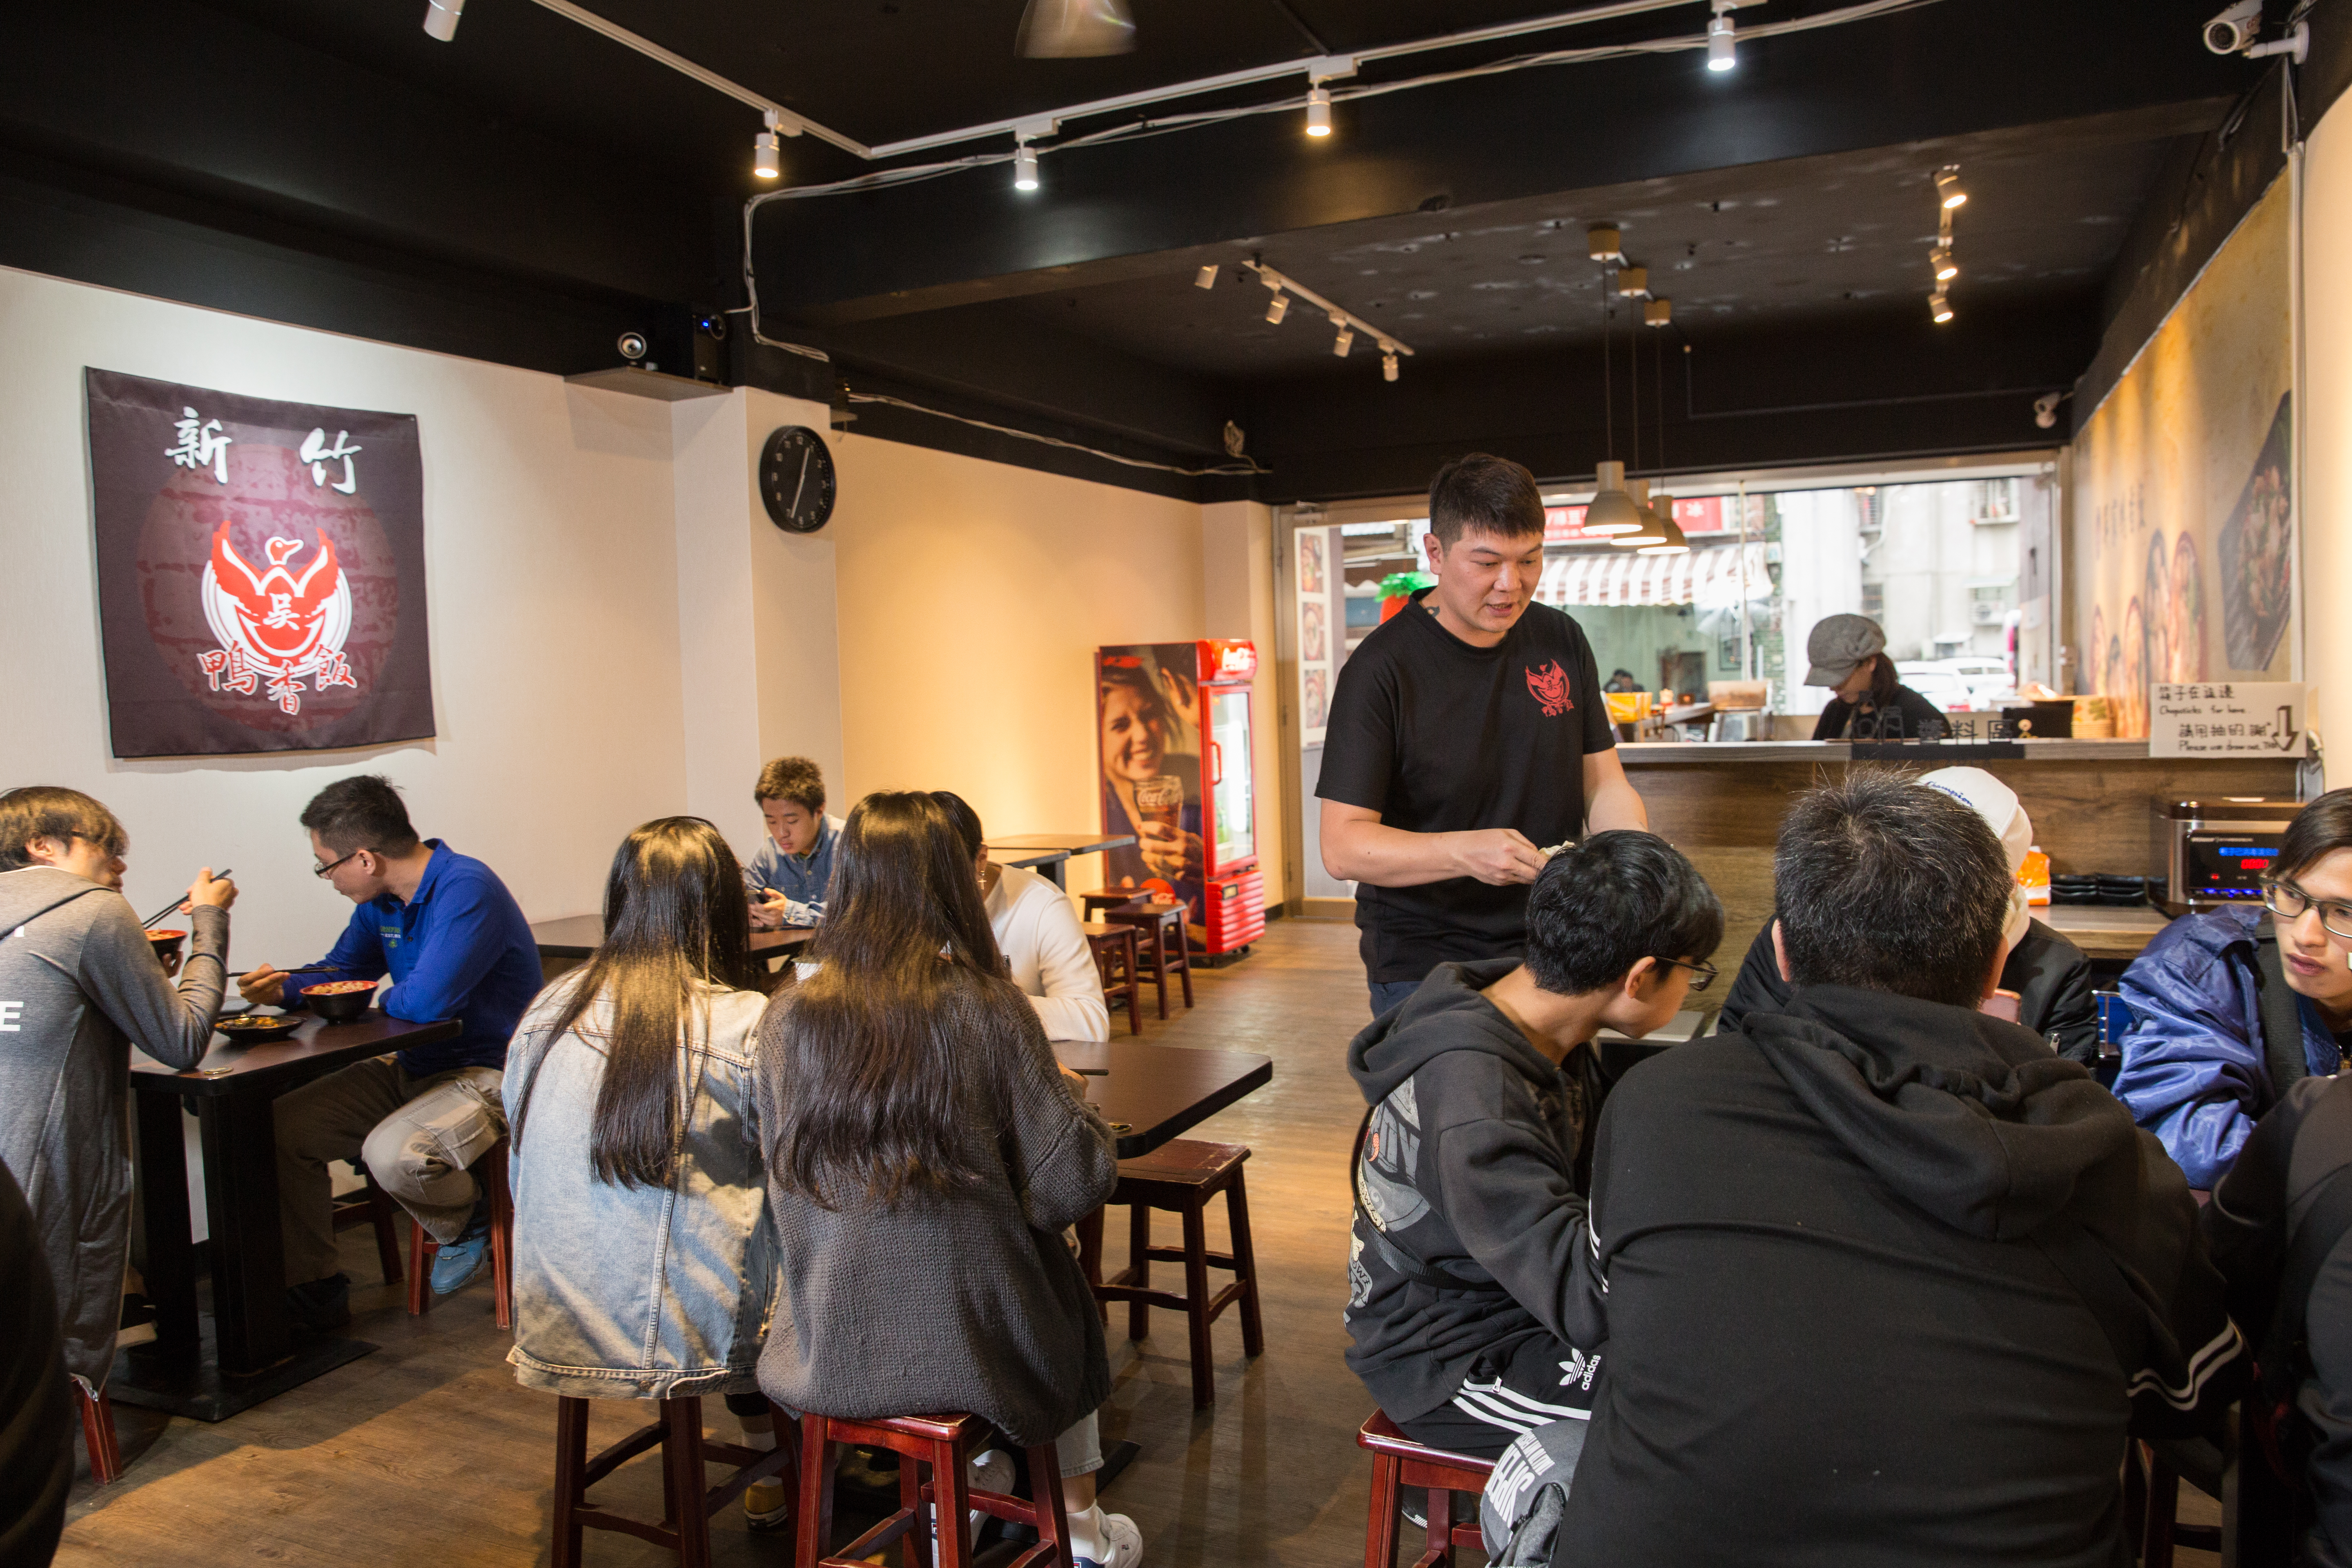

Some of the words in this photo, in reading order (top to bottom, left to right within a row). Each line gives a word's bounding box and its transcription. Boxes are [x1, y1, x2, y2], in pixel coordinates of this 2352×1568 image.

[164, 406, 363, 494] 新竹
[262, 592, 301, 630] 吳
[197, 640, 358, 715] 鴨香飯
[1581, 1354, 1601, 1390] adidas
